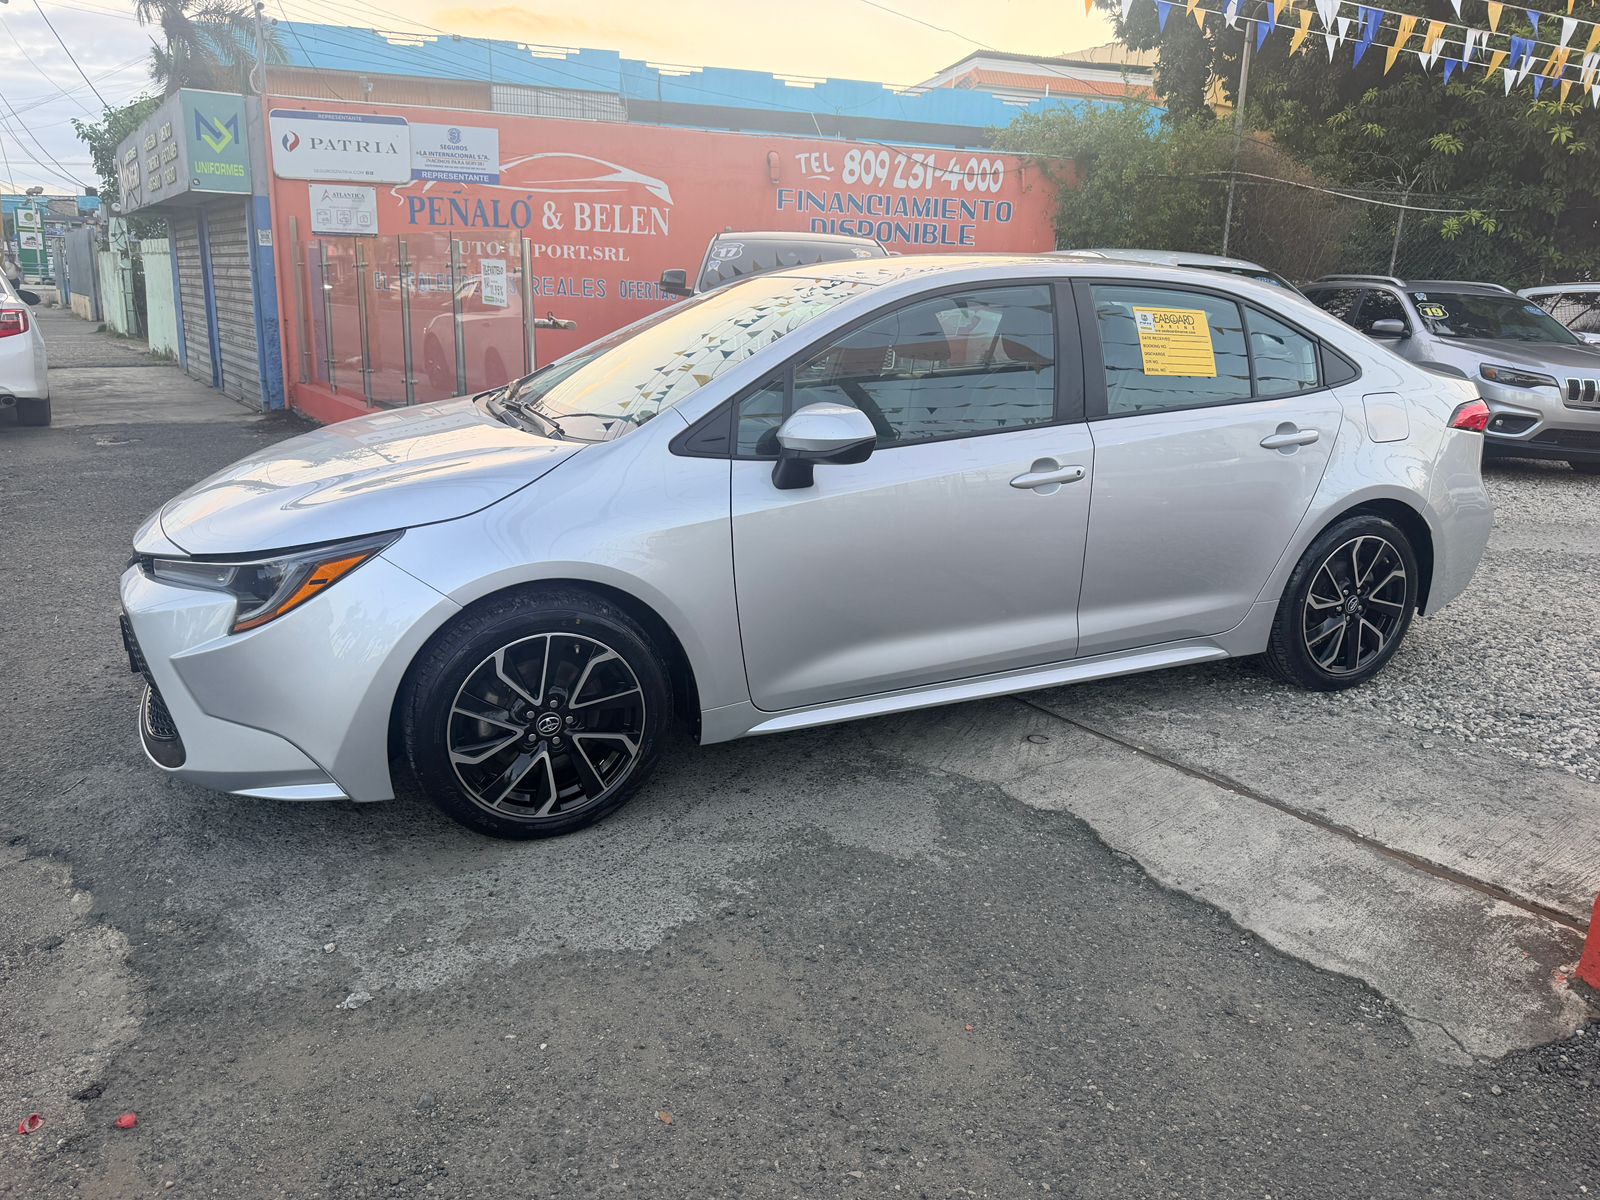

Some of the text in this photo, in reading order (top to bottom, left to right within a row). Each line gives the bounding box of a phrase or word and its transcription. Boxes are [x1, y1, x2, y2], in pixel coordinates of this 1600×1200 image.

[309, 137, 399, 155] PATRIA
[194, 161, 245, 177] UNIFORMES
[421, 171, 489, 182] REPRESENTANTE
[795, 149, 1005, 193] TEL 809 231-4000
[775, 188, 1013, 223] FINANCIAMIENTO
[542, 200, 564, 231] &
[574, 202, 671, 236] BELEN
[809, 217, 976, 247] DISPONIBLE
[718, 248, 738, 257] 17
[532, 276, 607, 299] REALES
[1153, 313, 1194, 325] EABOARD
[1423, 307, 1443, 317] 19
